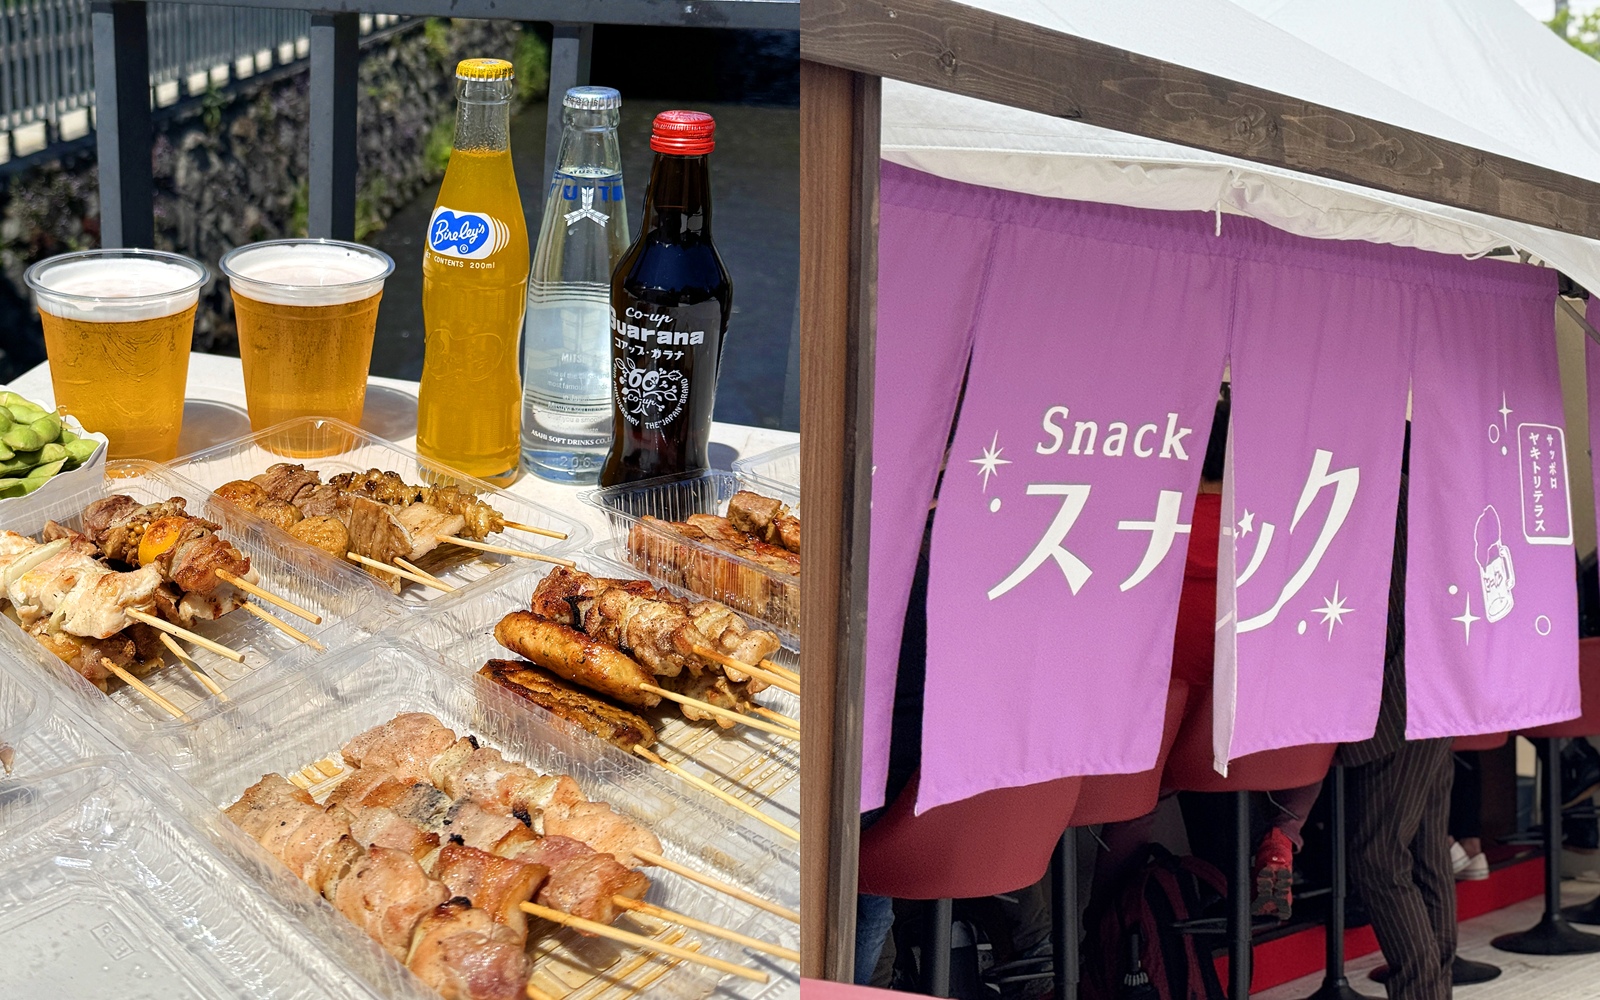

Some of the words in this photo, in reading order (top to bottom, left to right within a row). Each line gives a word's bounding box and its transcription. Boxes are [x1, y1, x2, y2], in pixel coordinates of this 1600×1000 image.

[433, 219, 485, 246] Bireley's
[434, 255, 464, 268] CONTENTS
[470, 261, 495, 269] 200ml
[531, 429, 548, 440] ASAHI
[548, 435, 566, 445] SOFT
[1035, 406, 1193, 461] Snack
[1546, 433, 1558, 490] サッポロ
[1528, 432, 1546, 533] ヤキトリテラス
